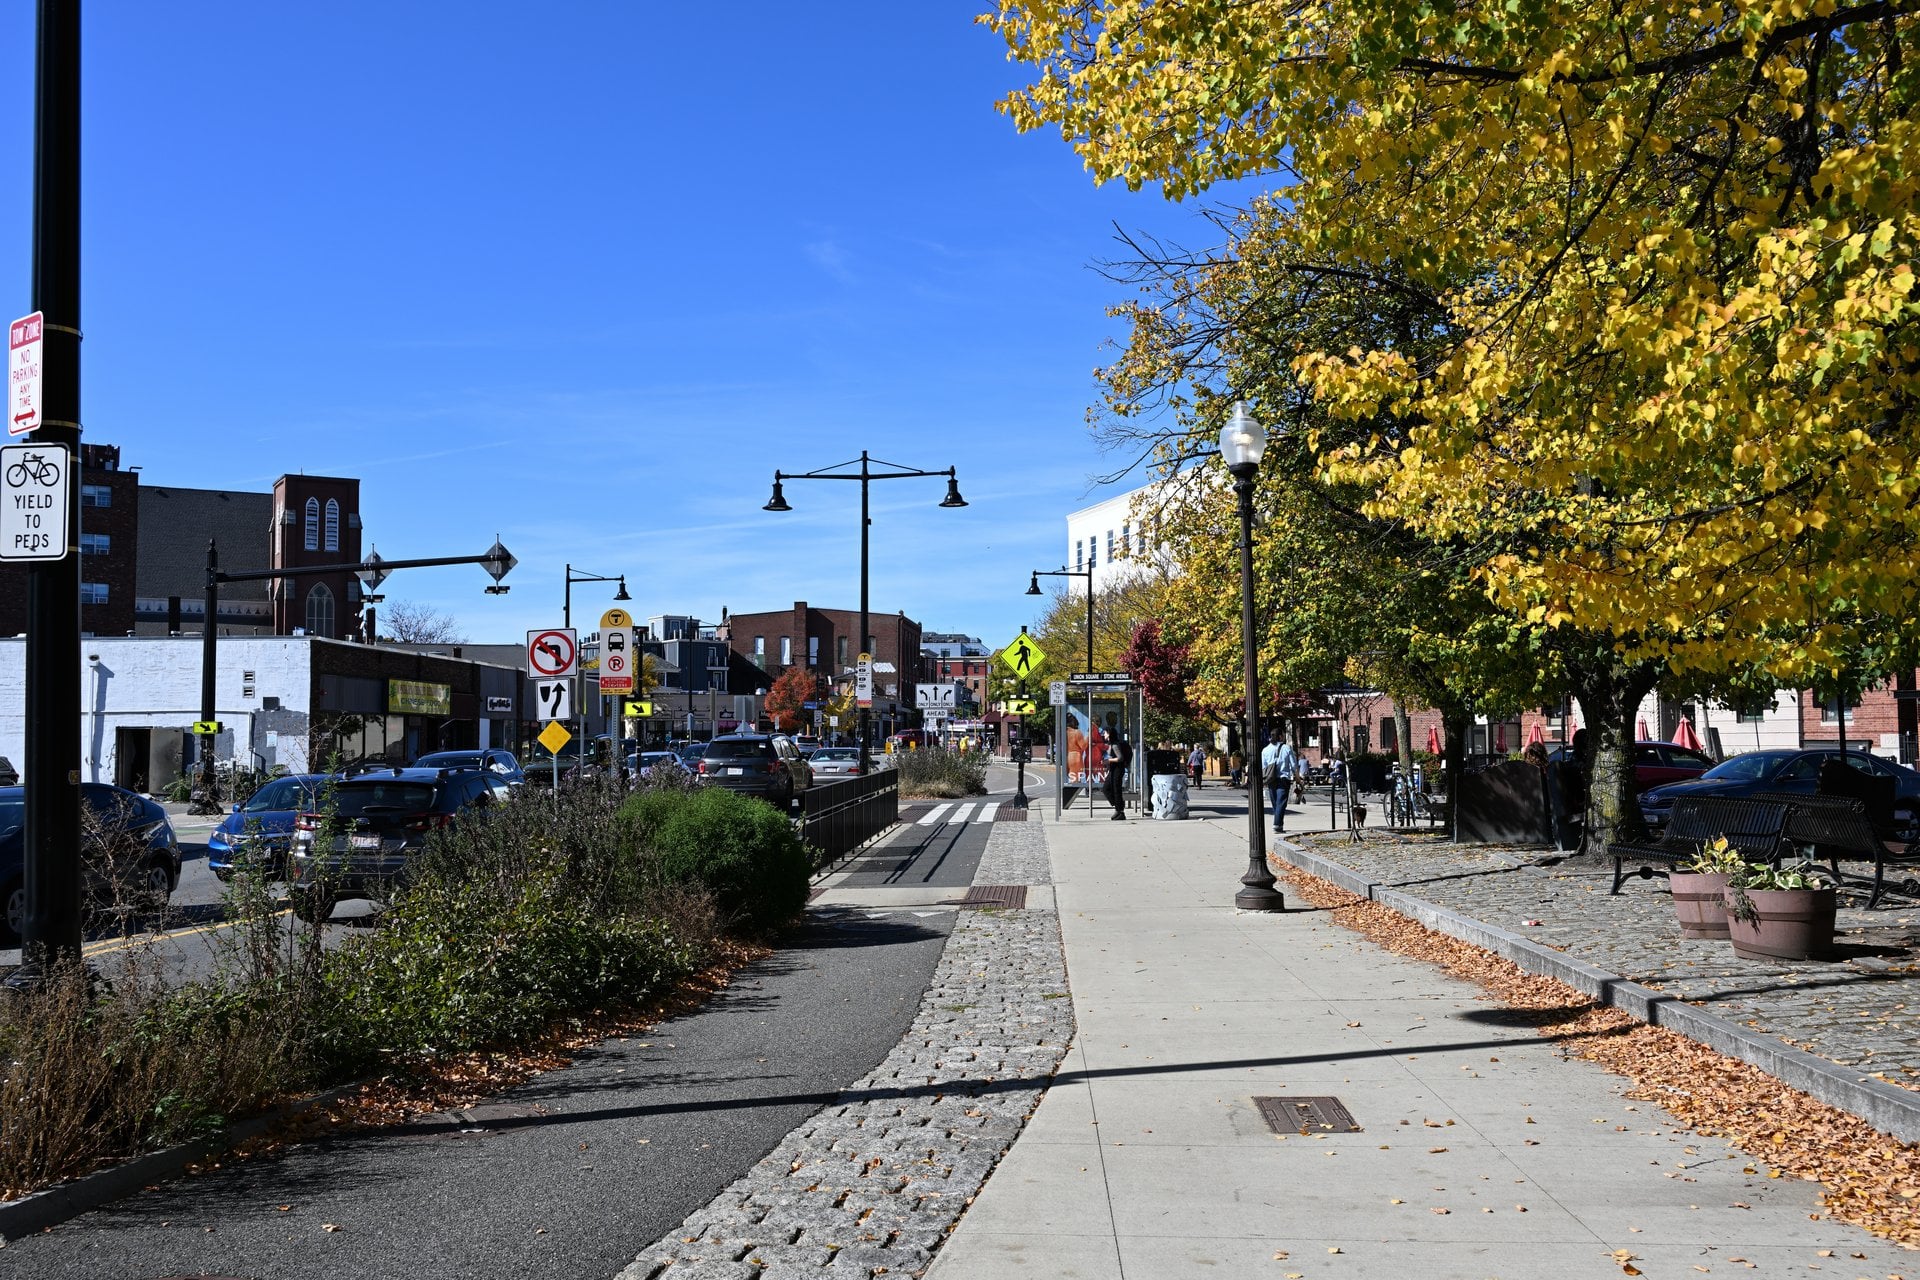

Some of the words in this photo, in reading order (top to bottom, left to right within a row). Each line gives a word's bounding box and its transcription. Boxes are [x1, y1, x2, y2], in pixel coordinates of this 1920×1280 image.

[12, 327, 24, 346] TOW
[25, 320, 41, 341] ZONE
[20, 348, 31, 366] NO
[12, 362, 38, 384] PARKING
[19, 383, 31, 396] ANY
[19, 394, 31, 409] TIME
[14, 494, 53, 510] YIELD
[25, 514, 41, 529] TO
[15, 533, 49, 549] PEDS
[611, 613, 622, 623] T
